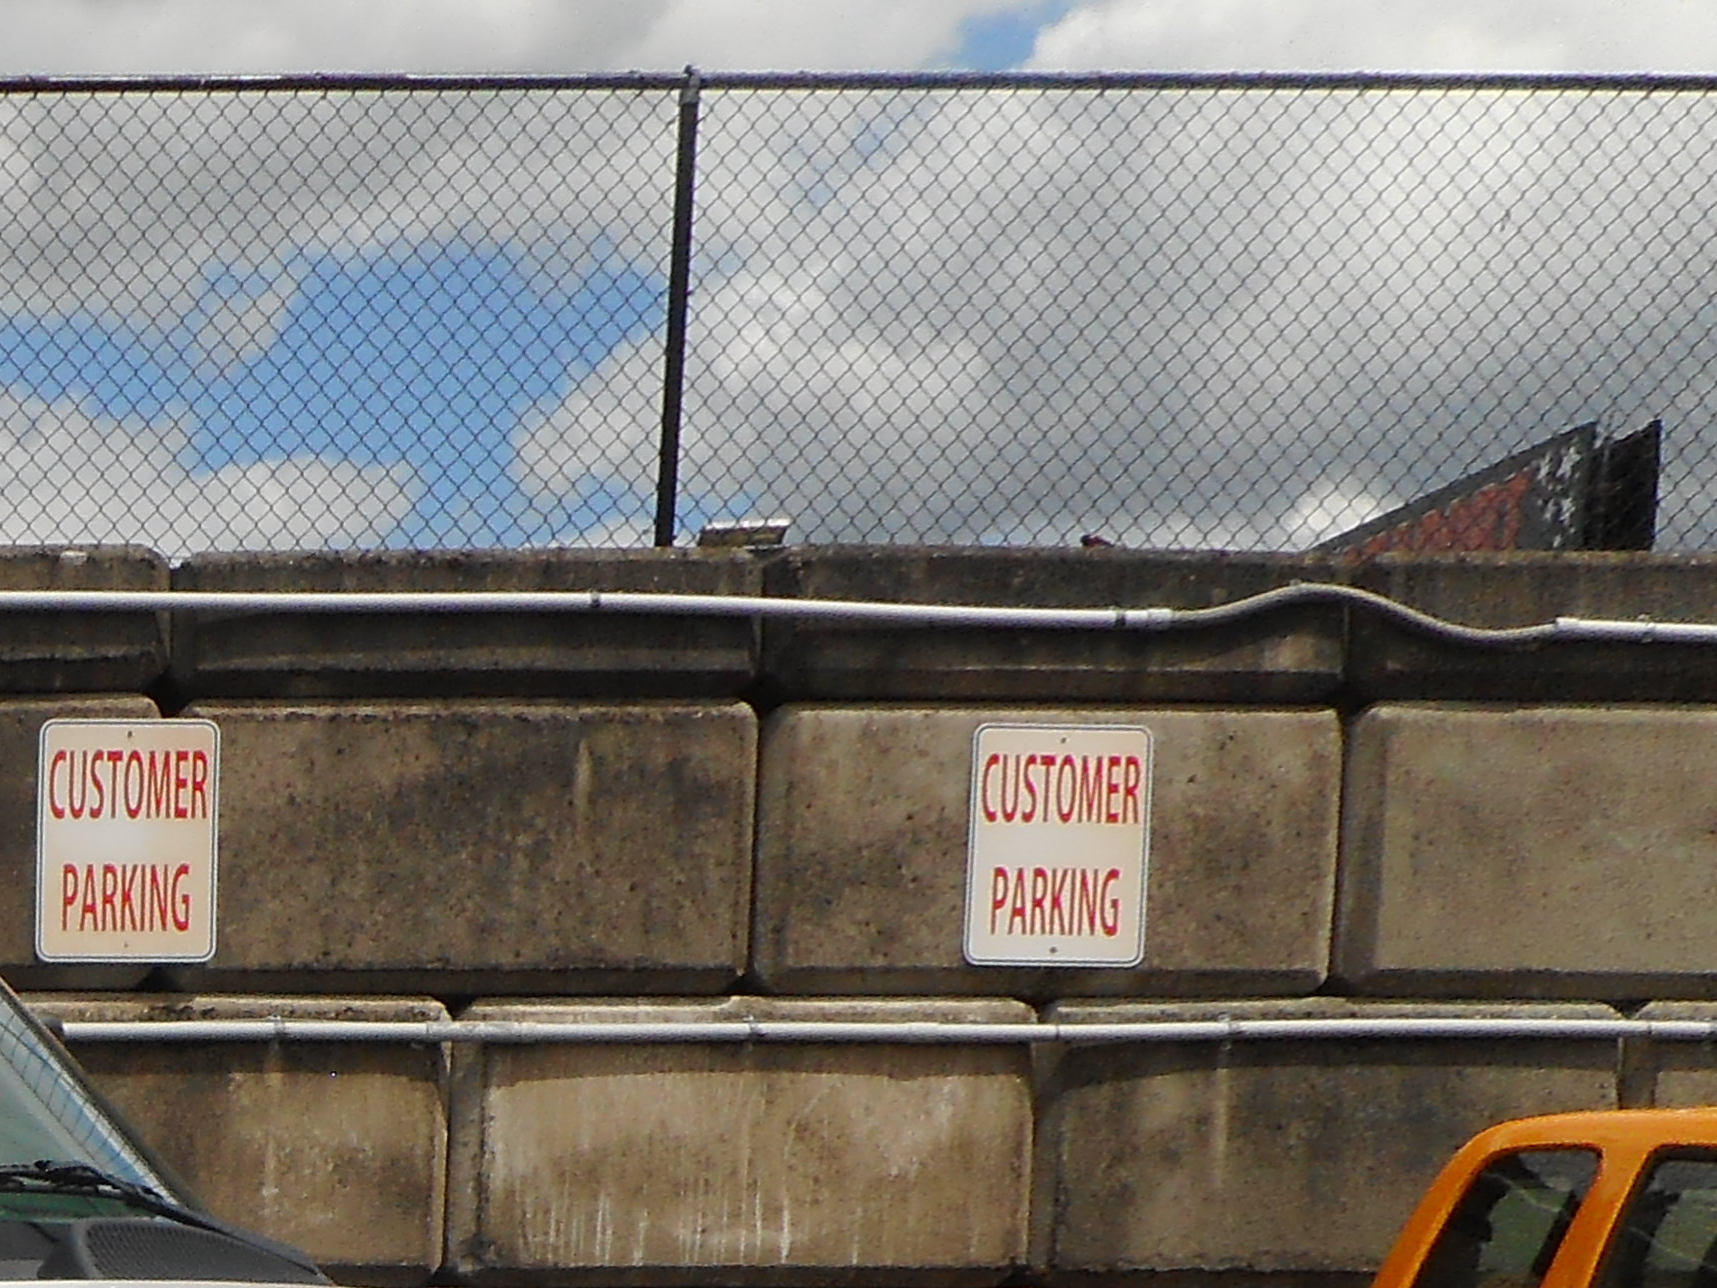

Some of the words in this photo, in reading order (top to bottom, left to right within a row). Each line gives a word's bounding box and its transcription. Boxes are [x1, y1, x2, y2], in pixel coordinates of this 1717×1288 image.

[49, 750, 208, 820] CUSTOMER
[981, 753, 1141, 824] CUSTOMER
[62, 863, 190, 932] PARKING
[991, 867, 1121, 937] PARKING
